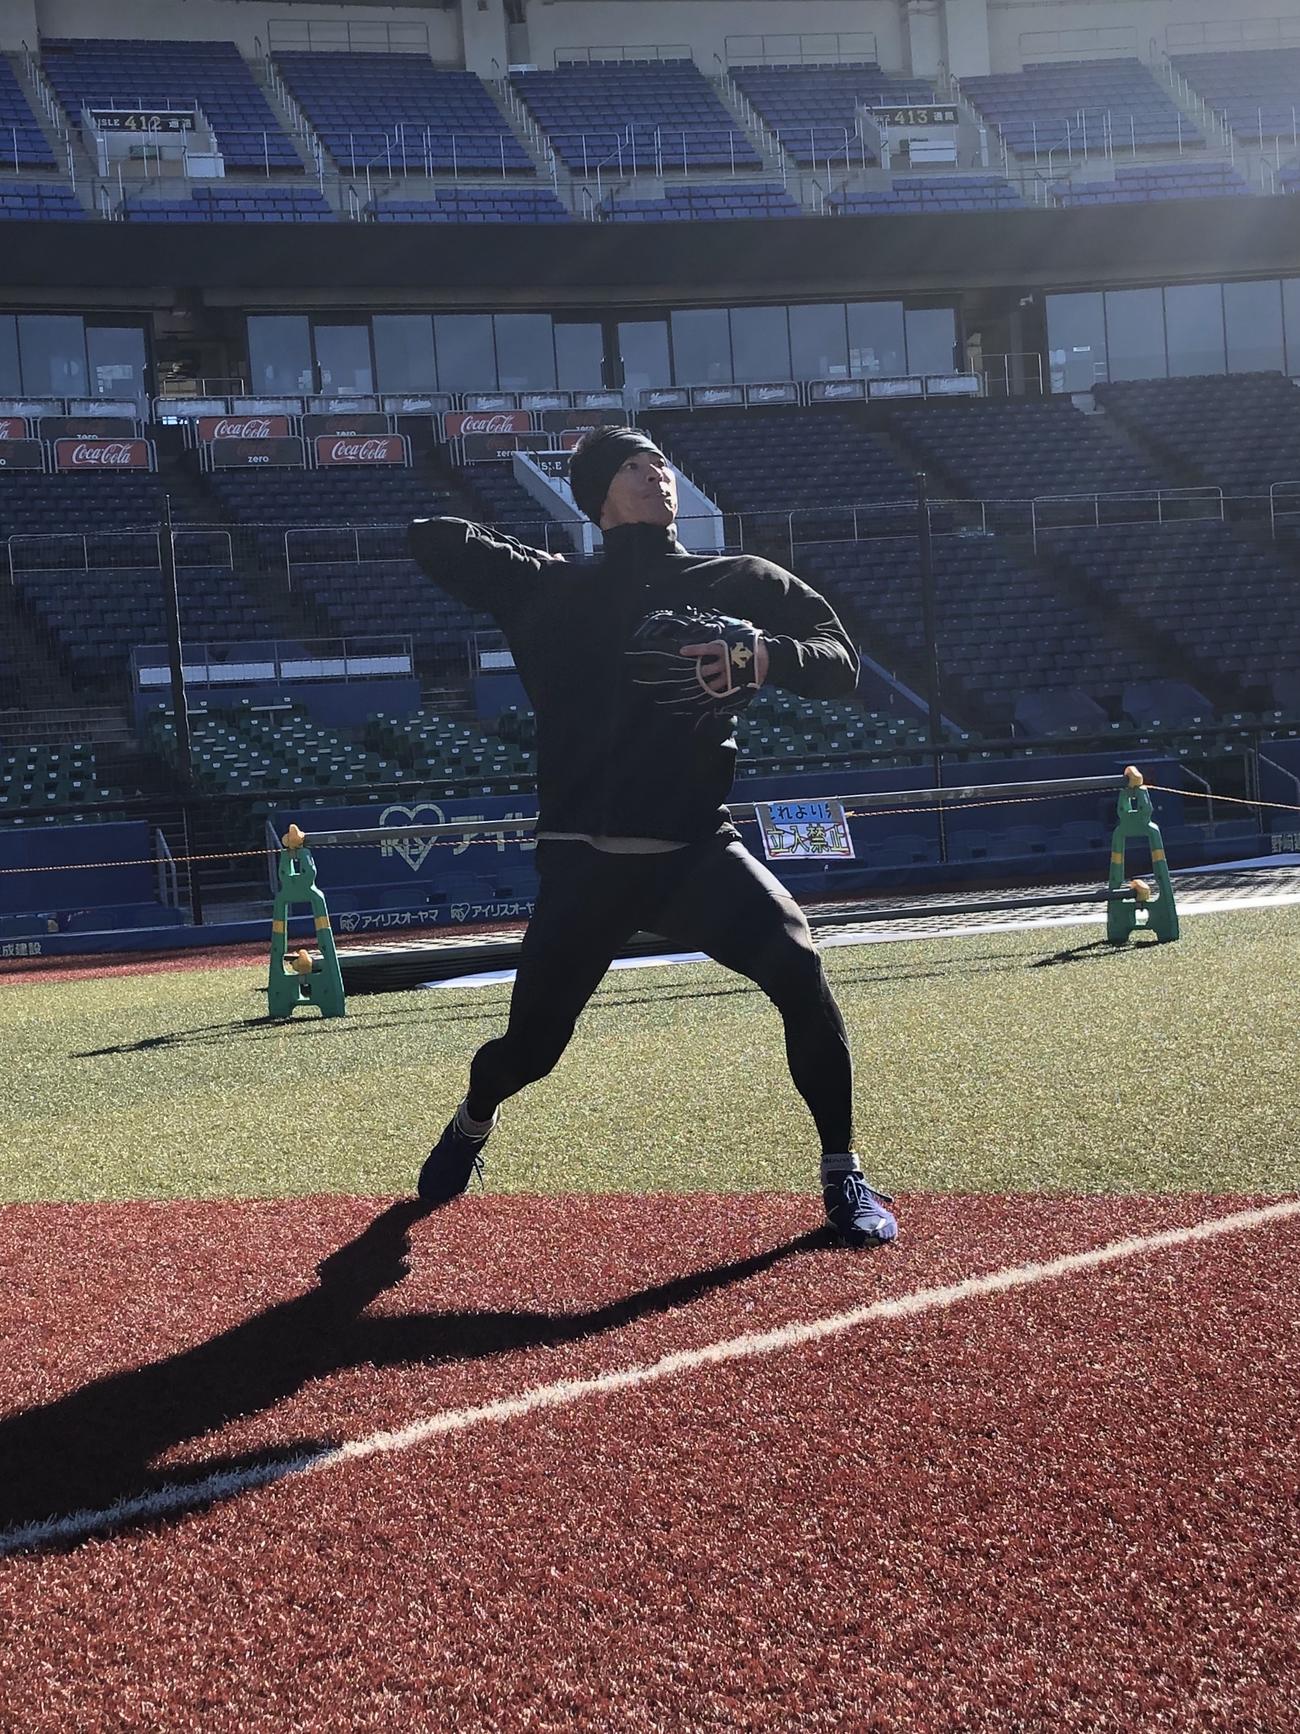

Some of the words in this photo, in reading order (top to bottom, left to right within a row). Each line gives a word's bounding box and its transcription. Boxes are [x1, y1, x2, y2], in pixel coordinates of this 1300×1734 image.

[124, 116, 162, 130] 412
[894, 110, 928, 124] 413
[72, 442, 134, 464] Coca-Cola
[248, 455, 270, 463] zero
[331, 439, 391, 461] Coca-Cola
[767, 824, 850, 853] 立入禁止
[361, 909, 439, 930] アイリスオーヤマ
[0, 942, 42, 957] 成建設
